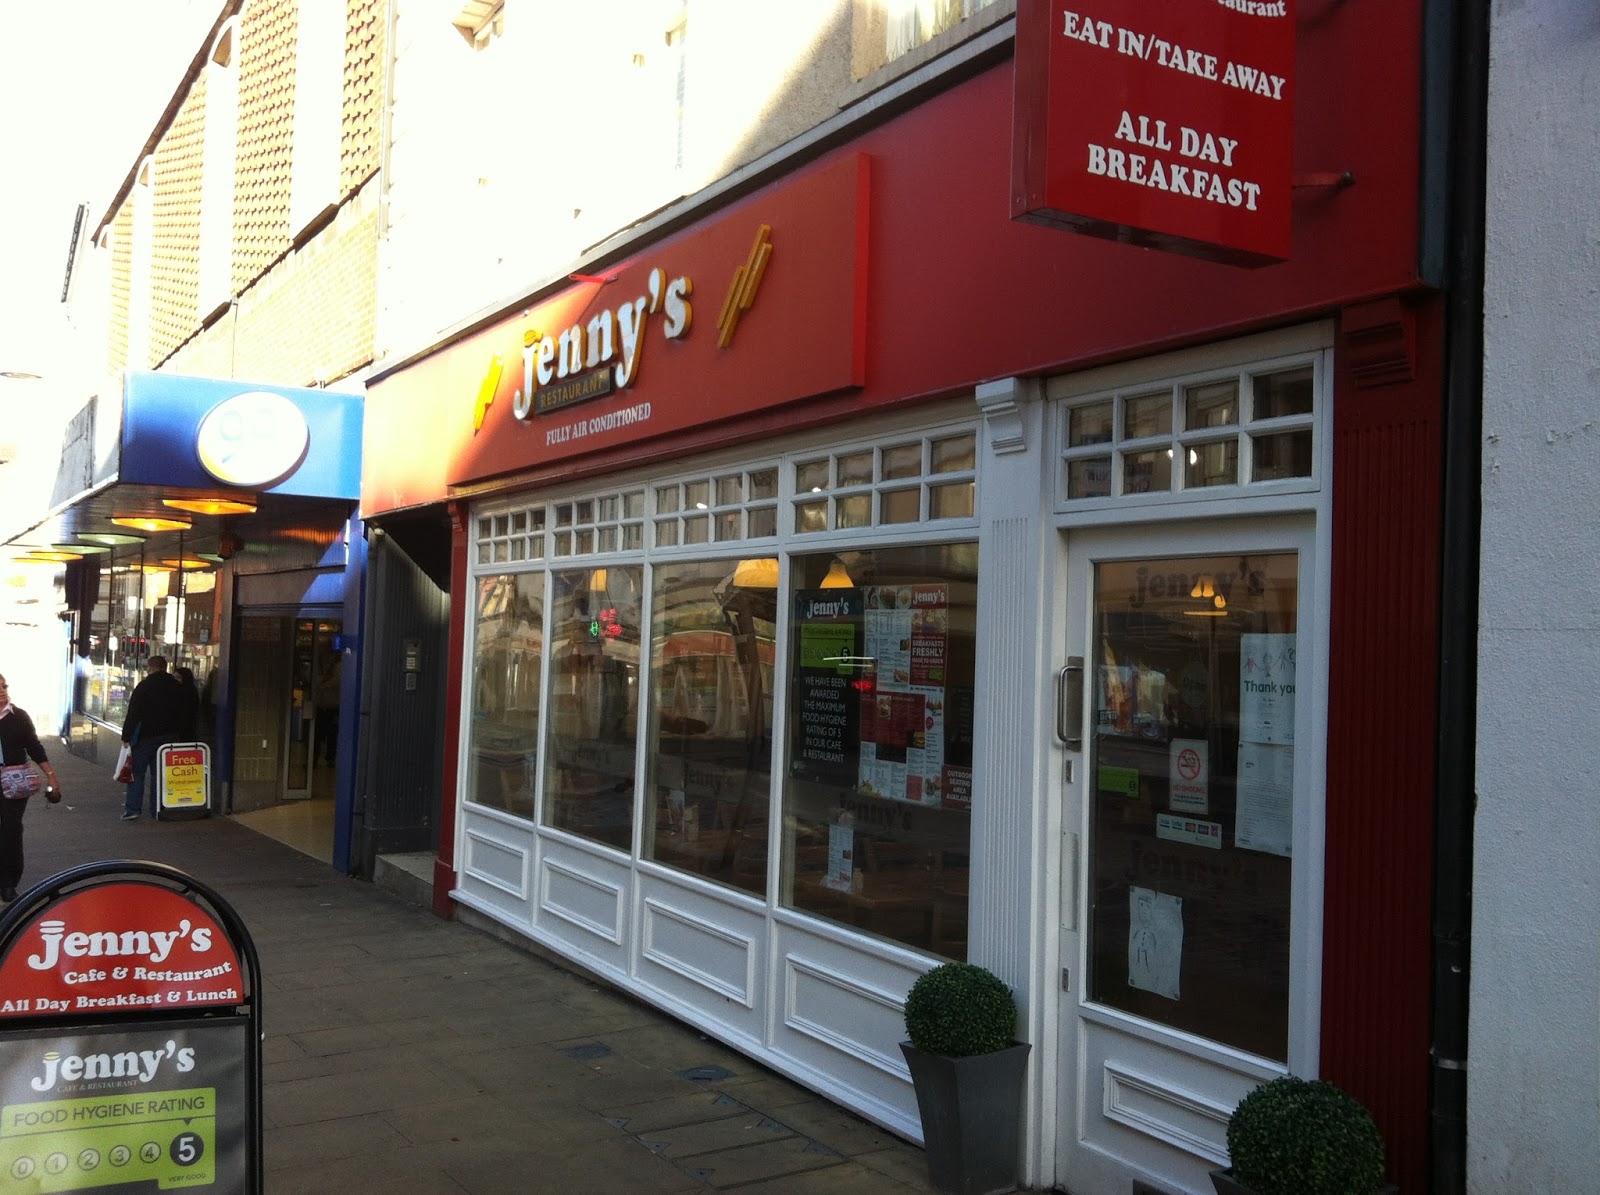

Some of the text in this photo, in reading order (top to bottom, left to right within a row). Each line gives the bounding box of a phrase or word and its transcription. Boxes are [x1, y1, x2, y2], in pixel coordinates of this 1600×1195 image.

[1063, 10, 1286, 101] EAT IN/TAKE AWAY
[1115, 110, 1239, 167] ALL DAY
[1087, 143, 1261, 212] BREAKFAST
[512, 267, 693, 421] jenny's
[540, 376, 603, 408] RESTAURANT
[546, 402, 651, 446] FULLY AIR CONDITIONED
[913, 589, 945, 604] jenny's
[807, 597, 849, 619] jenny's
[912, 647, 944, 656] FRESHLY
[805, 676, 848, 688] WE HAVE BEEN
[1244, 680, 1277, 693] Thank
[809, 689, 840, 700] AWARDED
[804, 700, 846, 713] THE MAXIMUM
[802, 712, 847, 726] FOOD HYGIENE
[806, 725, 828, 736] RATING
[828, 727, 837, 737] OF
[805, 736, 842, 751] IN OUR CAFE
[172, 754, 196, 765] Free
[802, 748, 845, 763] & RESTAURANT
[172, 767, 197, 777] Cash
[949, 778, 970, 787] SEATING
[28, 919, 212, 970] jenny's
[64, 961, 232, 985] Cafe & Restaurant
[1, 988, 238, 1013] All Day Breakfast & Lunch
[31, 1040, 195, 1092] jenny's
[57, 1079, 138, 1093] CAFE & RESTAURANT
[14, 1096, 205, 1127] FOOD HYGIENE RATING
[178, 1136, 195, 1161] 5
